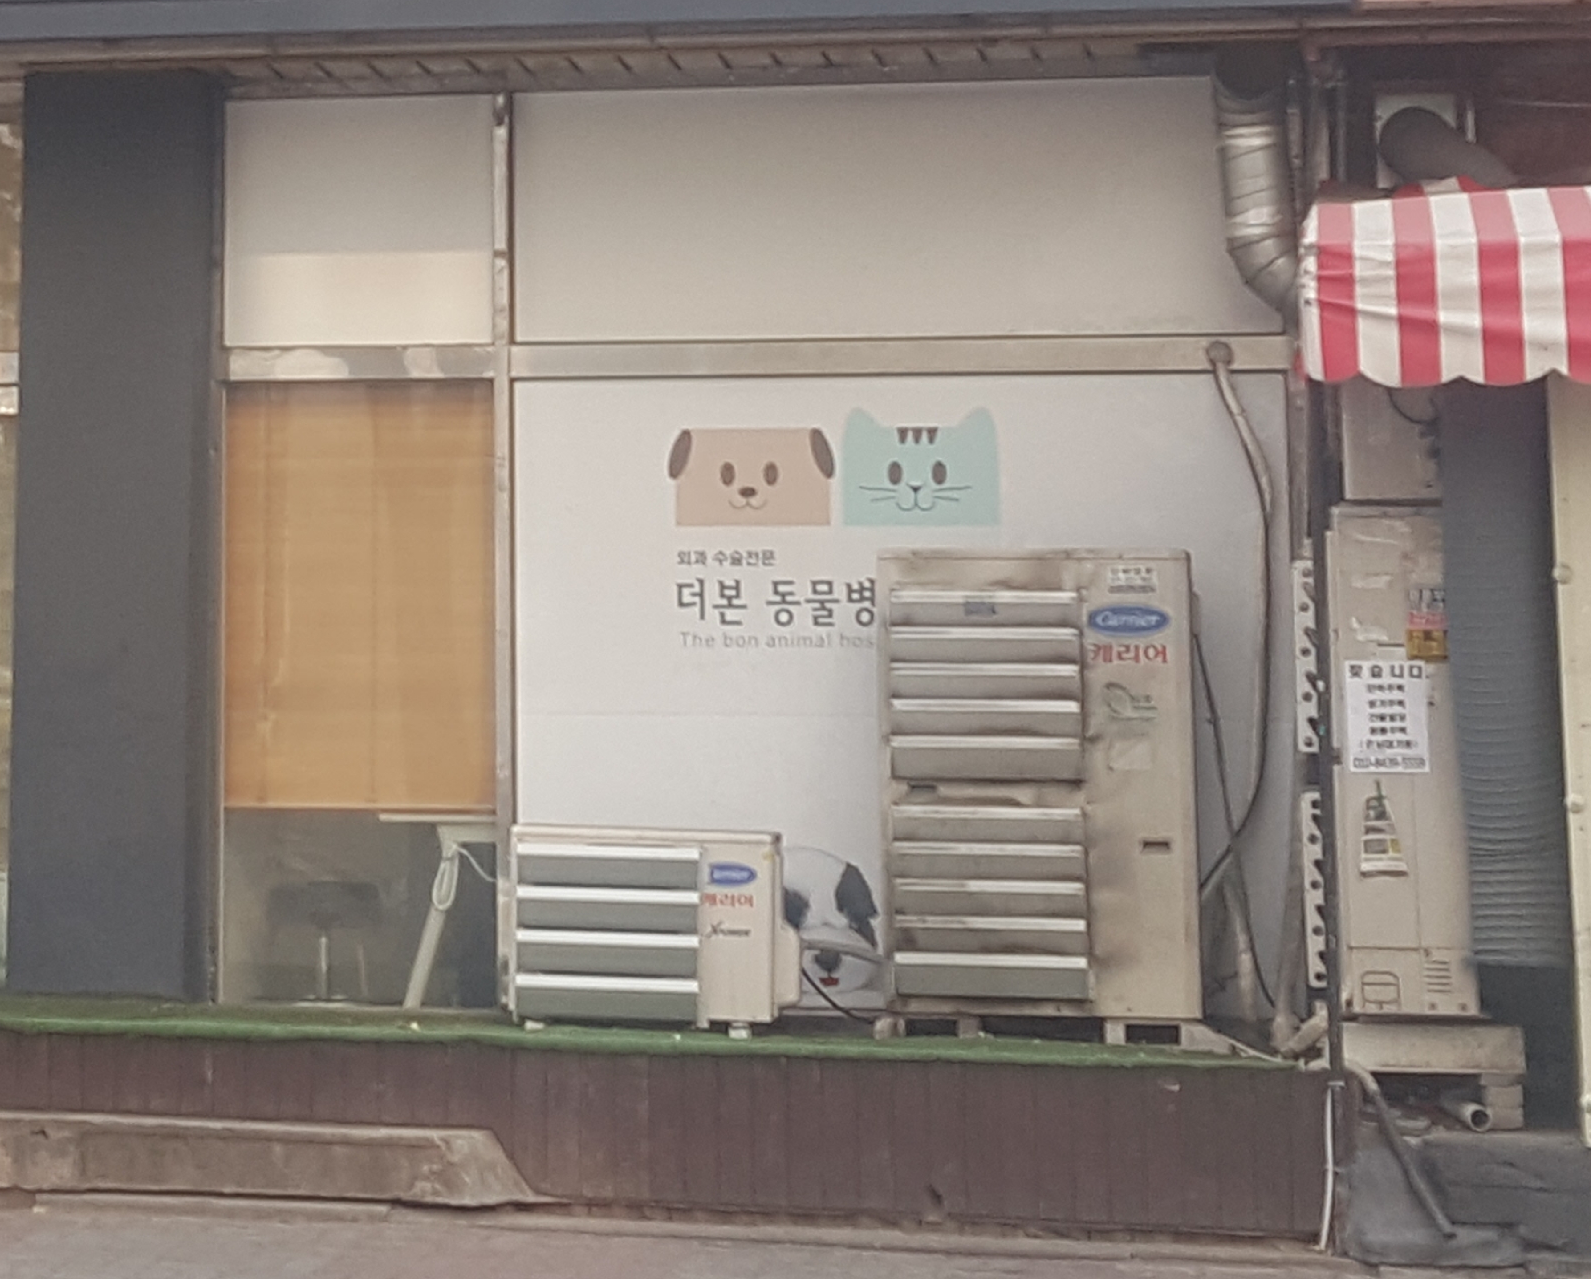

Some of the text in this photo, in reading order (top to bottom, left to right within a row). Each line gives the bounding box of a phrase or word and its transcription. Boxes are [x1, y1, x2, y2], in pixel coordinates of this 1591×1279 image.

[677, 549, 776, 567] 외과 수술전문
[676, 577, 876, 628] 더본 동물병
[681, 631, 715, 647] The
[723, 631, 759, 647] bon
[766, 631, 832, 648] animal
